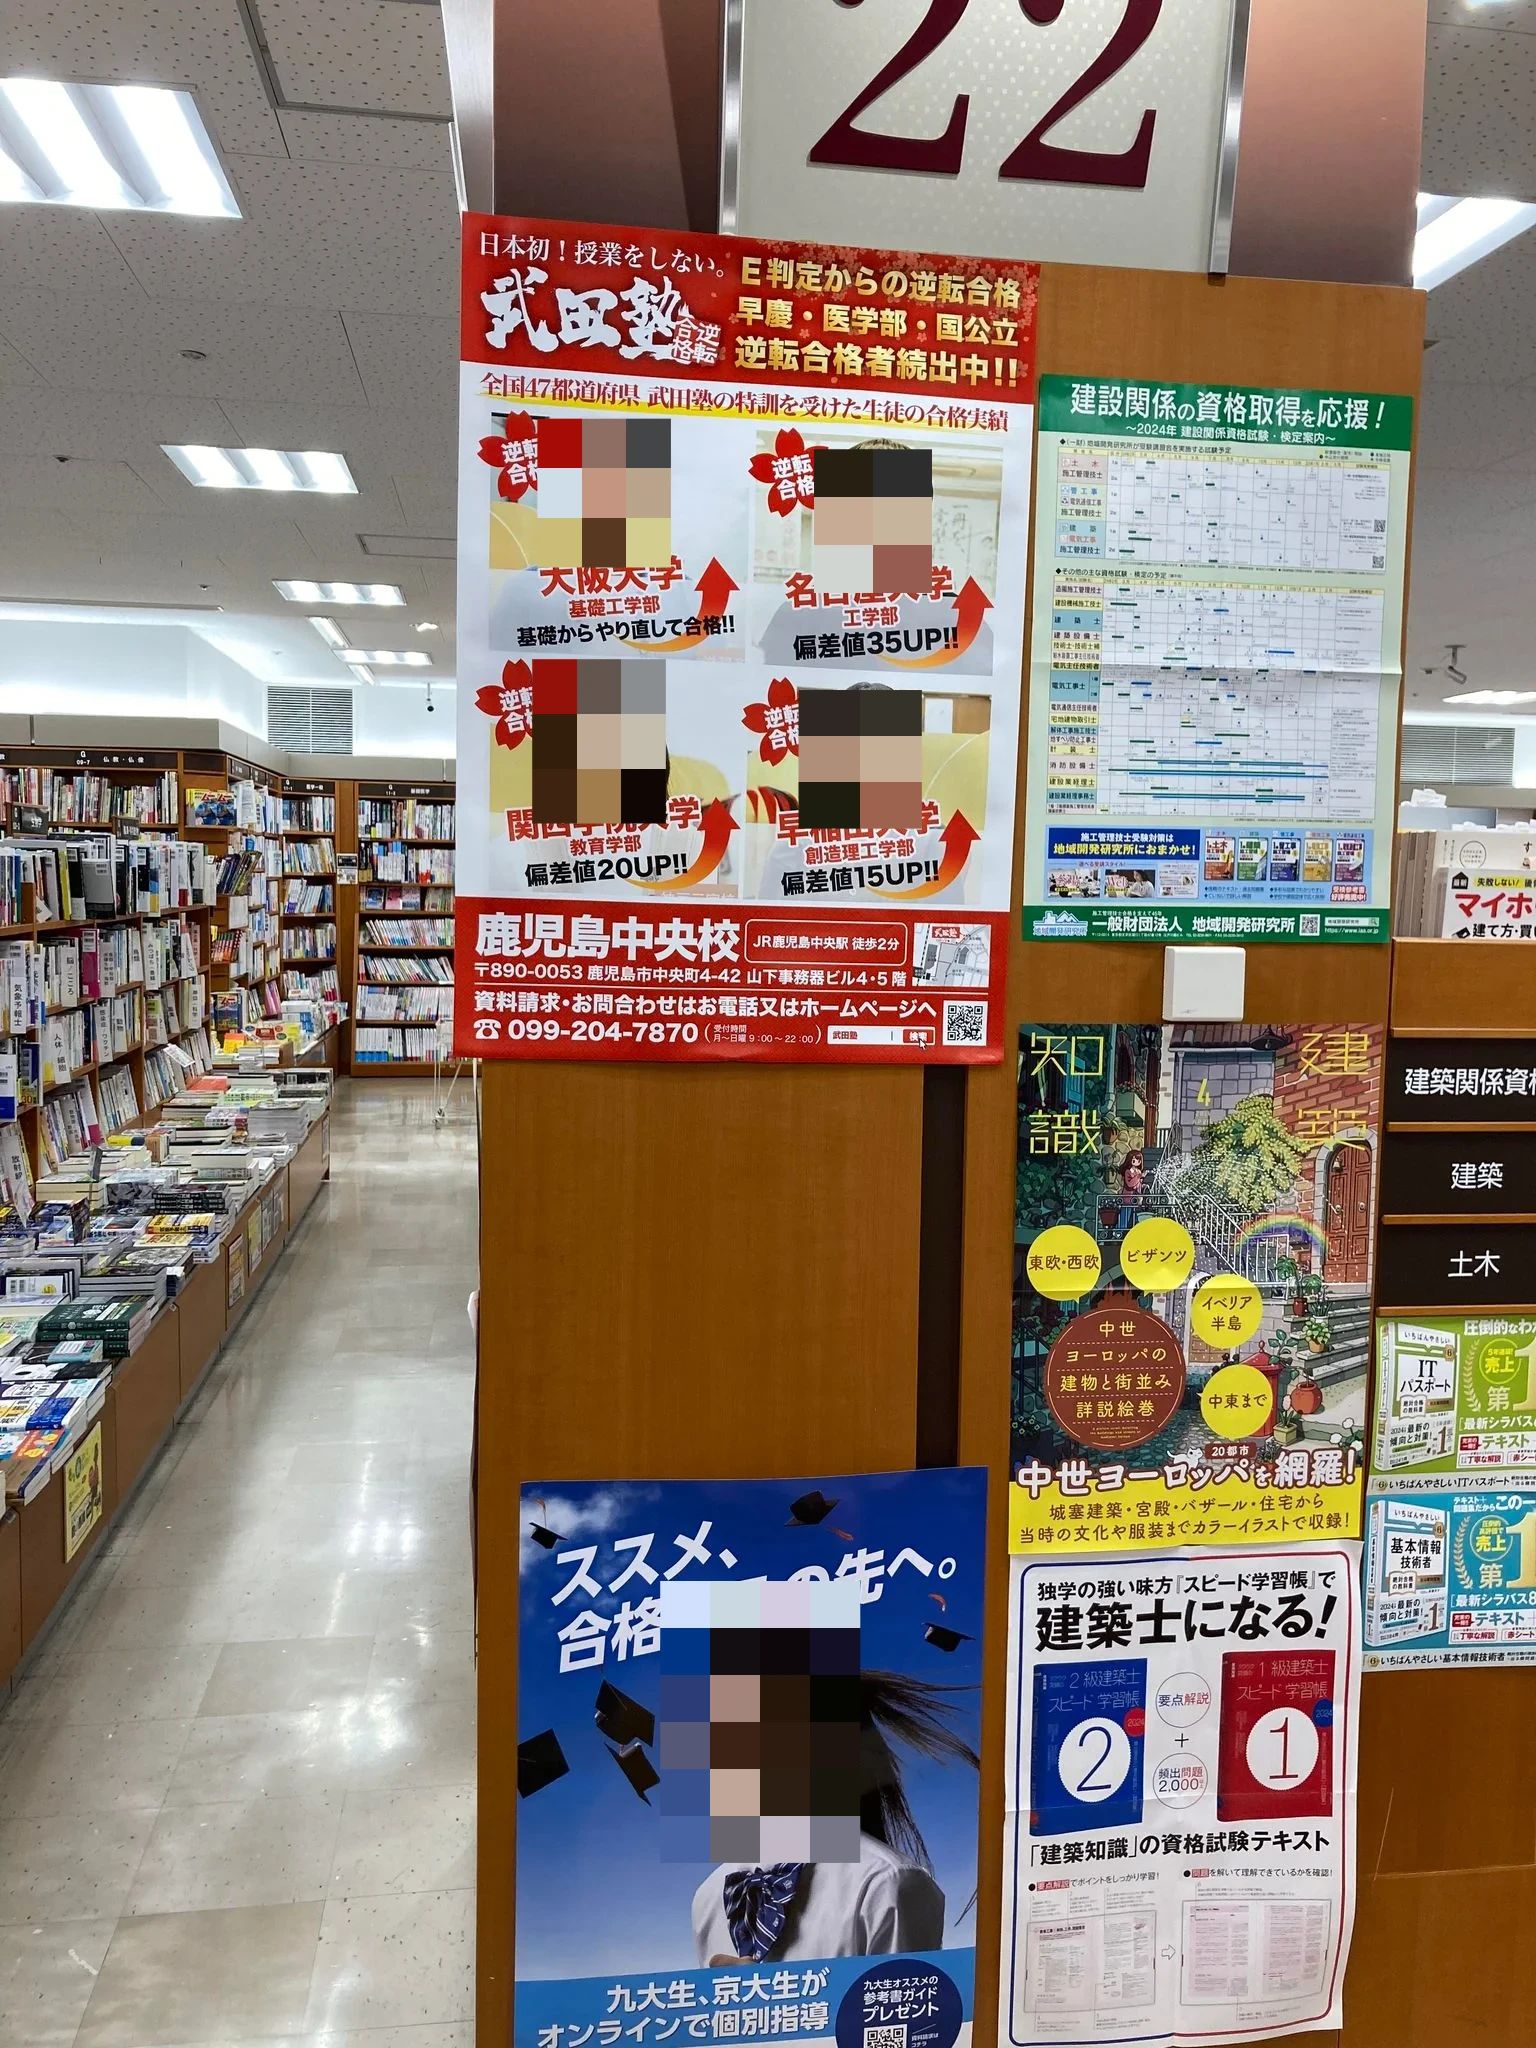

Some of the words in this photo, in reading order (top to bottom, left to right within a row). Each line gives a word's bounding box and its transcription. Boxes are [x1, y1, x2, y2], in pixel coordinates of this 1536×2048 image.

[808, 0, 1162, 187] 22
[480, 231, 724, 278] 日本初！授業をしない。
[741, 256, 1020, 309] E判定からの逆転合格
[480, 266, 690, 360] 武田塾
[736, 296, 1019, 347] 早慶・医学部・国公立
[673, 316, 695, 363] 合格
[693, 322, 721, 364] 逆転
[734, 335, 1018, 388] 逆転合格者続出中!!
[480, 372, 639, 406] 全国47都道府県
[647, 384, 1009, 432] 武田塾の特訓を受けた生徒の合格実績
[1070, 383, 1386, 430] 建設関係の資格取得を応援！
[771, 454, 813, 480] 逆転
[777, 475, 814, 501] 合格
[569, 595, 660, 618] 基礎工学部
[843, 606, 899, 628] 工学部
[516, 615, 735, 647] 基礎からやり直して合格!!
[793, 627, 958, 661] 偏差値35UP!!
[80, 750, 86, 758] G
[569, 835, 642, 857] 教育学部
[805, 838, 914, 865] 創造理工学部
[525, 853, 688, 887] 偏差値20UP!!
[781, 860, 939, 896] 偏差値15UP!!
[1455, 892, 1536, 919] マイホ
[1092, 916, 1182, 932] 一般財団法人
[1192, 917, 1296, 933] 地域開発研究所
[475, 912, 740, 963] 鹿児島中央校
[753, 935, 849, 950] JR鹿児島中央駅
[852, 938, 900, 951] 徒歩2分
[587, 965, 741, 984] 鹿児島市中央町4-42
[13, 984, 23, 1027] 気象予報士
[474, 990, 937, 1019] 資料請求・お問合わせはお電話又はホームページへ
[508, 1018, 699, 1043] 099-204-7870
[1029, 1032, 1104, 1154] 知識
[1450, 1162, 1503, 1189] 建築
[1028, 1253, 1100, 1271] 東欧・西欧
[1126, 1248, 1188, 1264] ビザンツ
[1448, 1250, 1501, 1277] 土木
[1202, 1295, 1252, 1311] イベリア
[1099, 1321, 1136, 1339] 中世
[1211, 1315, 1242, 1331] 半島
[1404, 1331, 1451, 1345] いちばんやさしい
[1066, 1347, 1167, 1363] ヨーロッパの
[1485, 1356, 1515, 1374] 売上
[1418, 1360, 1438, 1378] IT
[1060, 1372, 1172, 1392] 建物と街並み
[1400, 1378, 1451, 1393] パスポート
[1076, 1399, 1155, 1419] 詳説絵巻
[1208, 1394, 1267, 1410] 中東まで
[1211, 1445, 1249, 1457] 20都市
[1482, 1434, 1530, 1449] テキスト
[1017, 1449, 1356, 1498] 中世ヨーロッパを網羅!
[1050, 1492, 1324, 1519] 城塞建築・宮殿・バザール・住宅から
[1394, 1509, 1440, 1521] いちばんやさしい
[1020, 1513, 1349, 1544] 当時の文化や服装までカラーイラストで収録!
[1390, 1537, 1441, 1555] 基本情報
[1476, 1535, 1507, 1552] 売上
[552, 1520, 737, 1606] ススメ、
[1400, 1555, 1431, 1569] 技術者
[1037, 1570, 1336, 1601] 独学の強い味方『スピード学習帳』で
[1035, 1594, 1338, 1652] 建築士になる!
[1475, 1611, 1525, 1626] テキスト
[1069, 1668, 1141, 1689] 2級建築士
[1259, 1659, 1329, 1677] 1級建築士
[1048, 1690, 1141, 1712] スピード学習帳
[1158, 1693, 1210, 1707] 要点解説
[1236, 1681, 1328, 1700] スピード学習帳
[1077, 1726, 1112, 1792] 2
[1269, 1717, 1298, 1779] 1
[1158, 1766, 1204, 1780] 頻出問題
[1158, 1779, 1199, 1793] 2,000
[1030, 1831, 1330, 1868] 「建築知識」の資格試験テキスト
[606, 1966, 833, 2013] 九大生、京大生が
[864, 1975, 939, 1991] 九大生オススメの
[863, 1986, 938, 2006] 参考書ガイド
[863, 2001, 940, 2023] プレゼント
[537, 2001, 829, 2048] オンラインで個別指導
